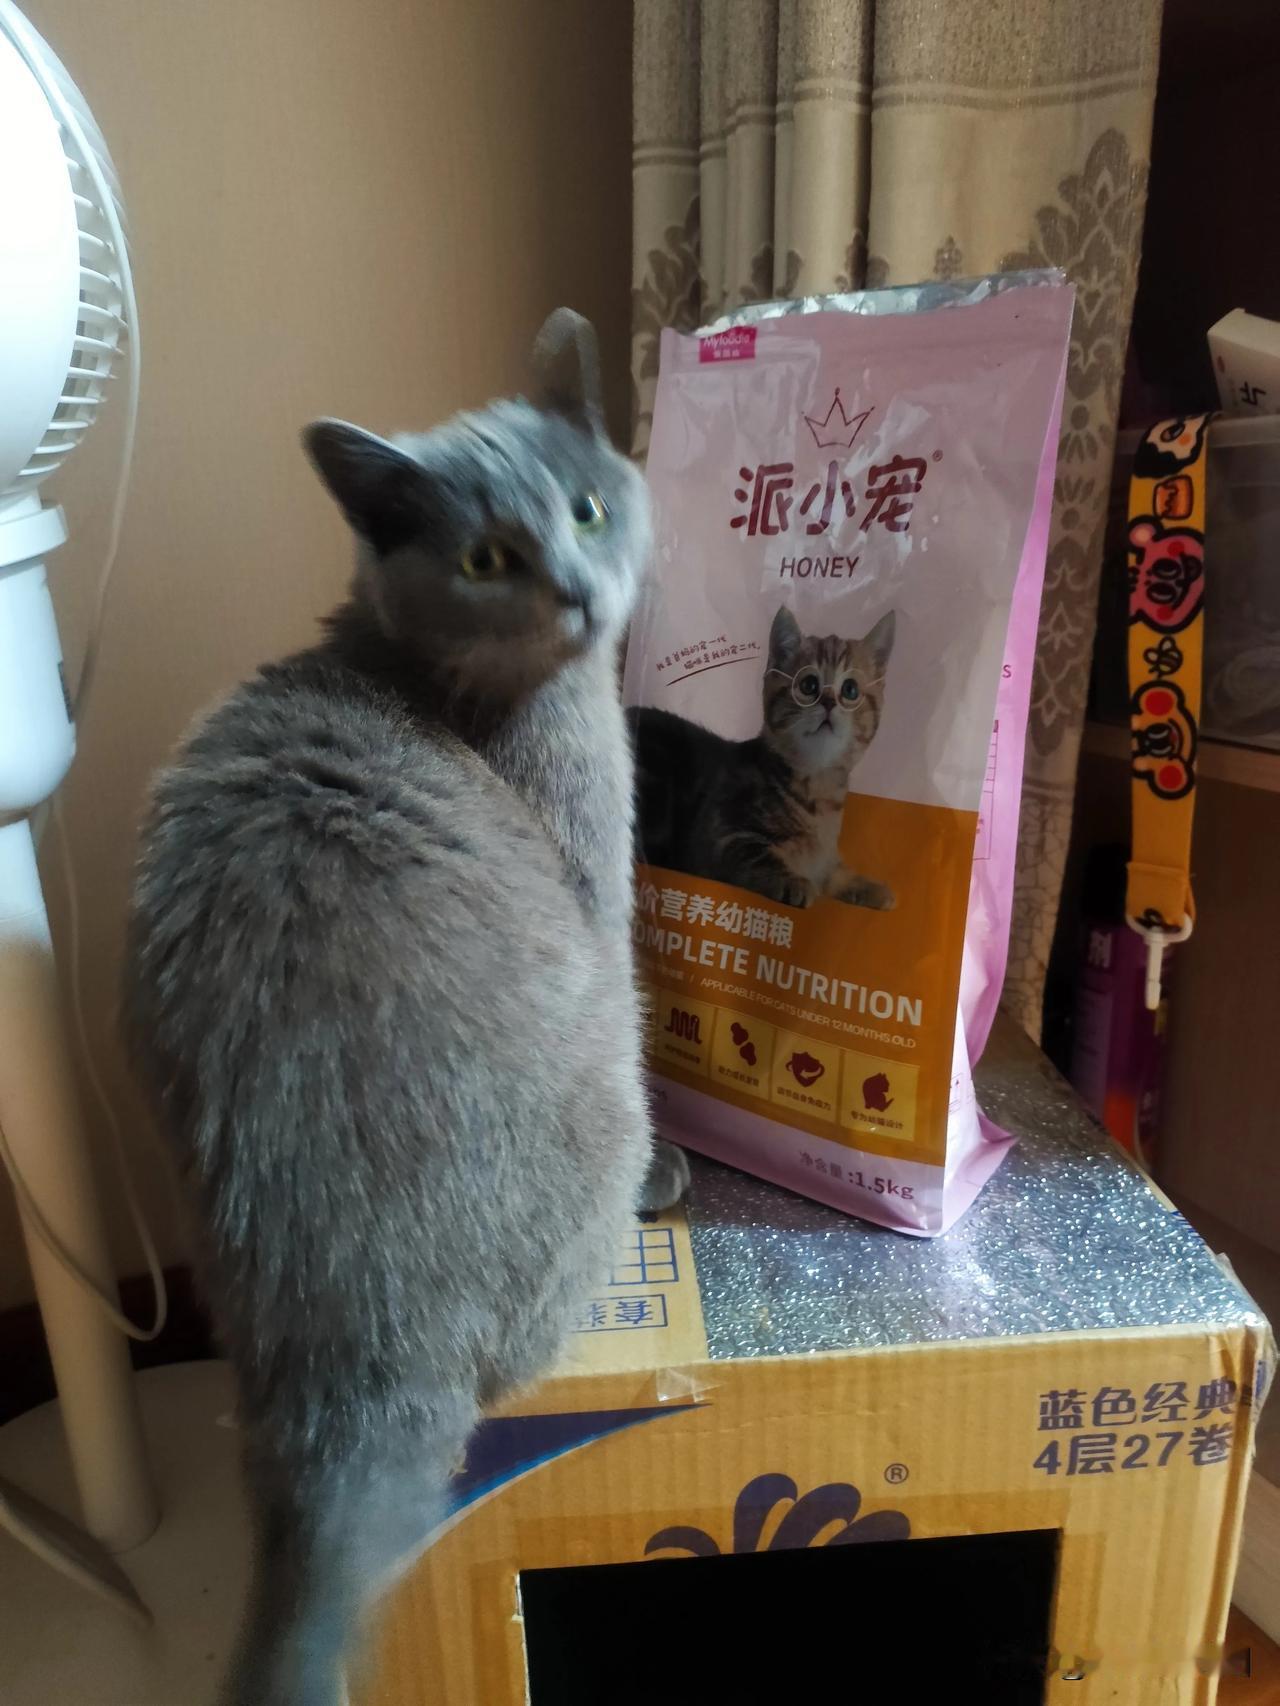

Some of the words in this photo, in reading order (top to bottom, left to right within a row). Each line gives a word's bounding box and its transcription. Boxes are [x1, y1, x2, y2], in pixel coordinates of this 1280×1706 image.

[730, 454, 927, 536] 派小宠
[780, 556, 859, 579] HONEY
[638, 881, 794, 949] 价营养幼猫粮
[632, 918, 750, 976] OMPLETE
[756, 954, 923, 1027] NUTRITION
[700, 977, 756, 1002] APPLICABLE
[797, 1010, 831, 1028] UNDER
[832, 1020, 842, 1030] 12
[843, 1022, 890, 1043] MONTHS
[891, 1034, 917, 1049] OLD
[1037, 1374, 1237, 1432] 蓝色经典
[1033, 1421, 1234, 1476] 4层27卷
